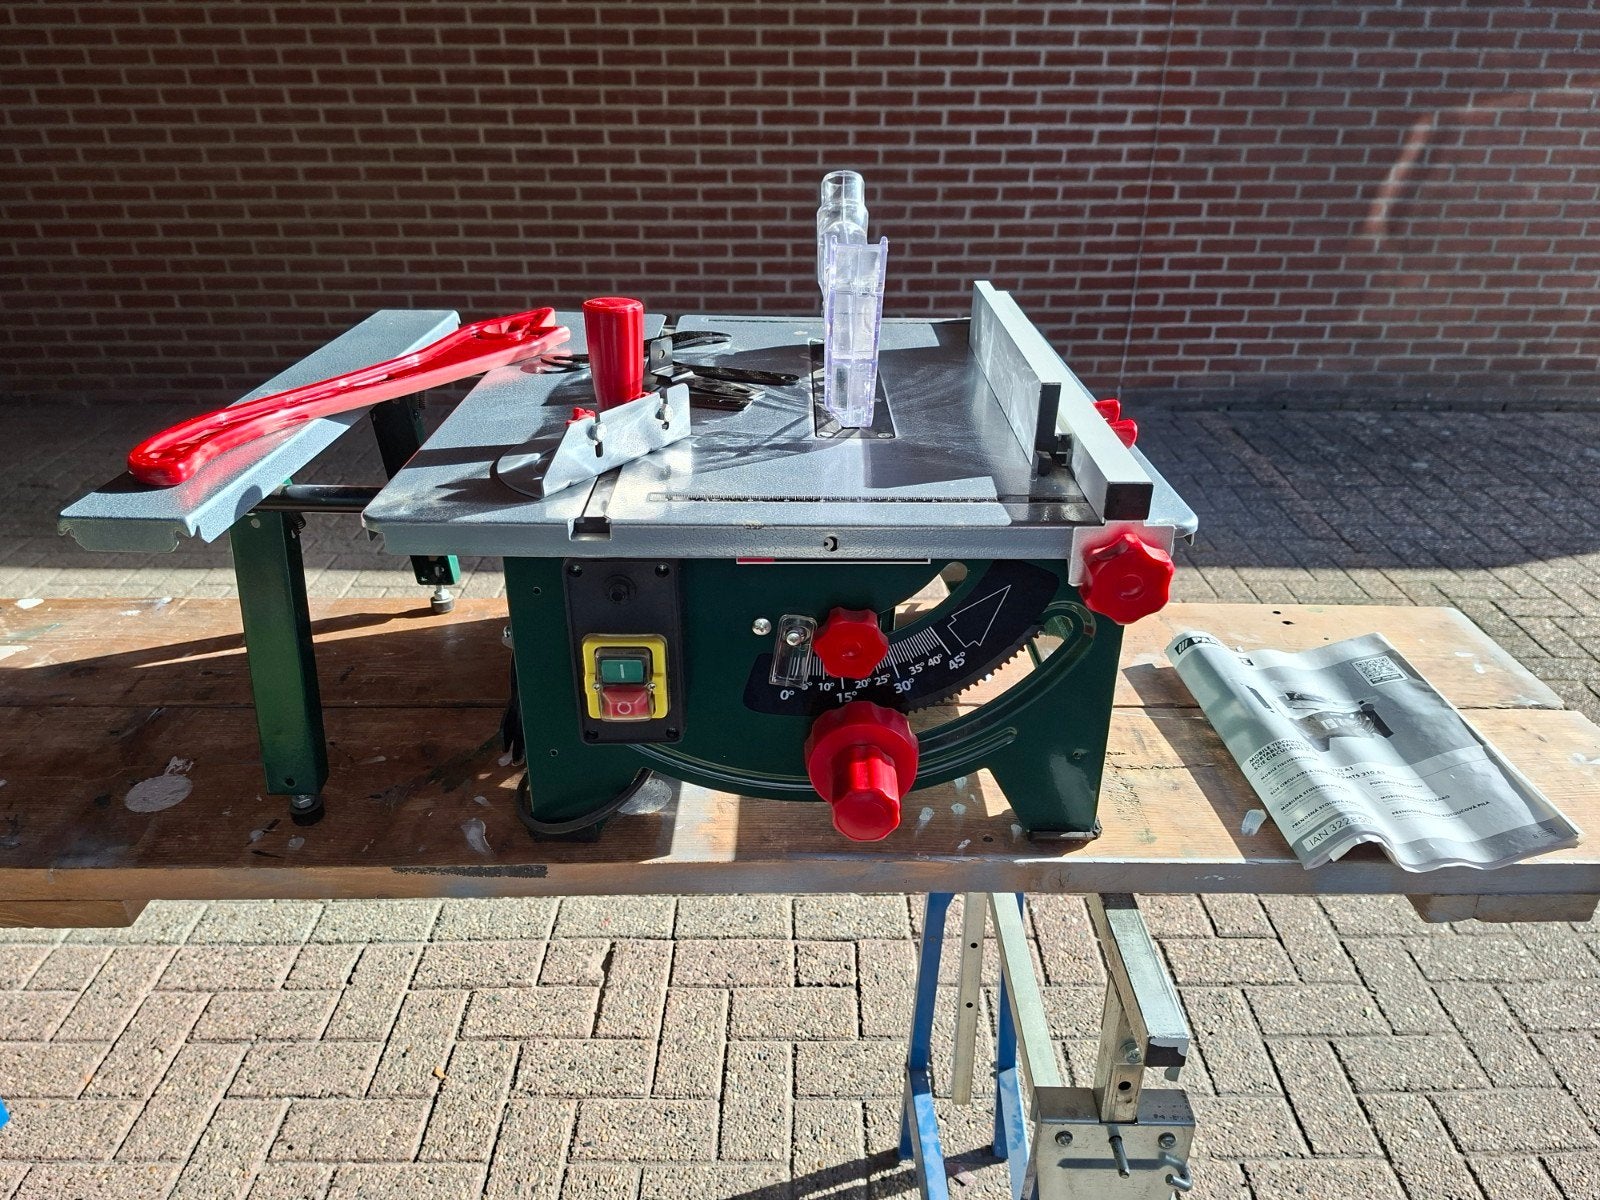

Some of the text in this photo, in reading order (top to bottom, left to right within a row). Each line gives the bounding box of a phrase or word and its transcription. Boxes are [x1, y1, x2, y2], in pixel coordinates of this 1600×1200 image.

[927, 654, 943, 666] 40°
[949, 652, 966, 670] 45°
[908, 662, 925, 675] 35°
[854, 678, 872, 689] 20°
[874, 673, 891, 686] 25°
[893, 678, 915, 694] 30°
[818, 682, 835, 691] 10°
[780, 689, 795, 700] 0°
[836, 691, 858, 703] 15°
[1249, 745, 1271, 764] MOBILE
[1251, 746, 1281, 767] PORTABLE
[1253, 760, 1266, 771] SCIE
[1308, 829, 1330, 846] IAN
